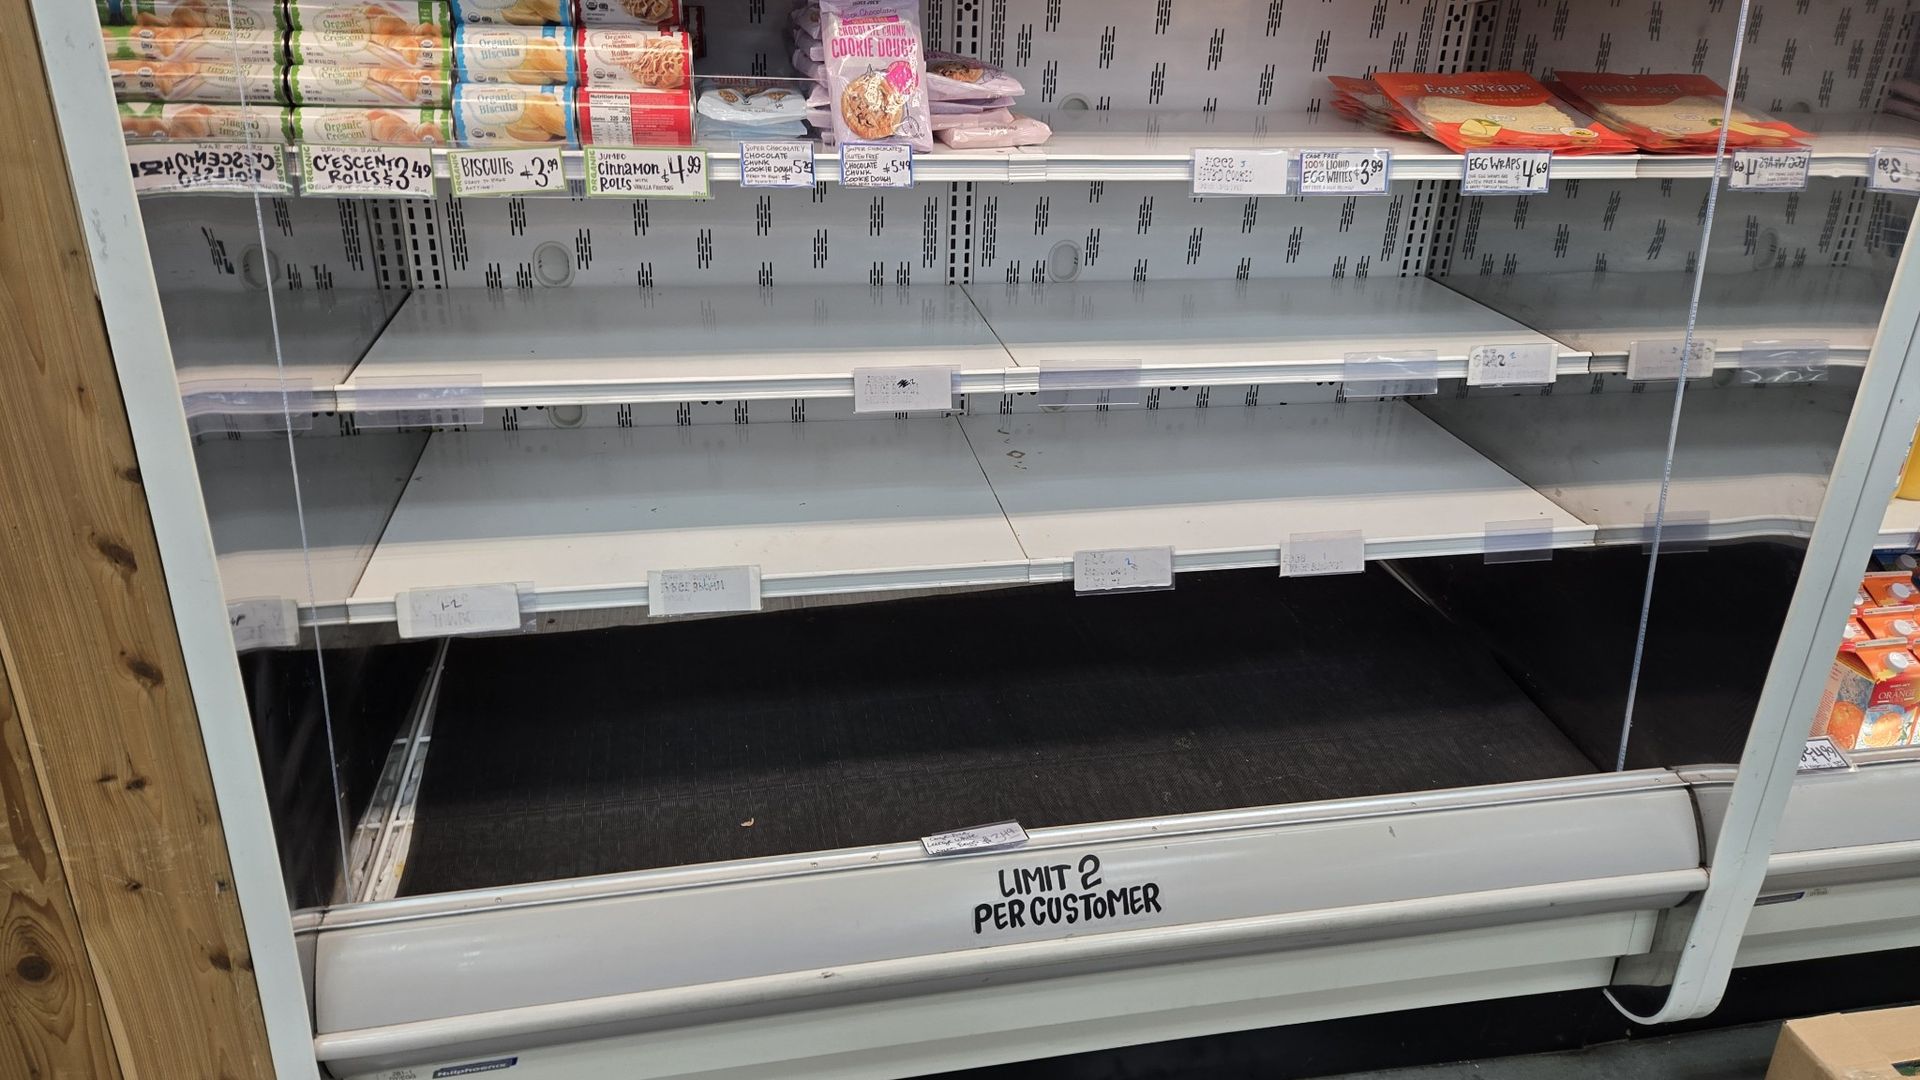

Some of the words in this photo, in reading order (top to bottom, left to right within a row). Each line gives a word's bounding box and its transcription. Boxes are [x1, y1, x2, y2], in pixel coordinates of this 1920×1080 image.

[479, 38, 518, 50] Organic
[832, 37, 874, 58] COOKIE
[481, 48, 520, 60] Biscuits
[477, 92, 517, 105] Organic
[479, 103, 519, 115] Biscuits
[323, 120, 362, 132] Organic
[744, 143, 765, 152] SUPER
[743, 152, 789, 160] CHOCOLATE
[1323, 152, 1339, 160] FREE
[302, 146, 315, 190] ORGANIC
[773, 165, 794, 173] DOUGH
[845, 161, 878, 170] CHOCOLATE
[1304, 159, 1325, 169] 100%
[1325, 159, 1351, 170] LIQUID
[1469, 157, 1489, 171] EGG
[1489, 156, 1522, 171] WRAPS
[588, 150, 598, 192] ORGANIC
[1303, 170, 1326, 184] EGG
[1326, 170, 1354, 184] WHITES
[328, 170, 381, 186] ROLLS
[870, 175, 892, 183] DOUGH
[998, 864, 1072, 898] LIMIT
[1077, 854, 1102, 891] 2
[974, 898, 1026, 935] PER
[1029, 882, 1162, 926] CUSTOMER
